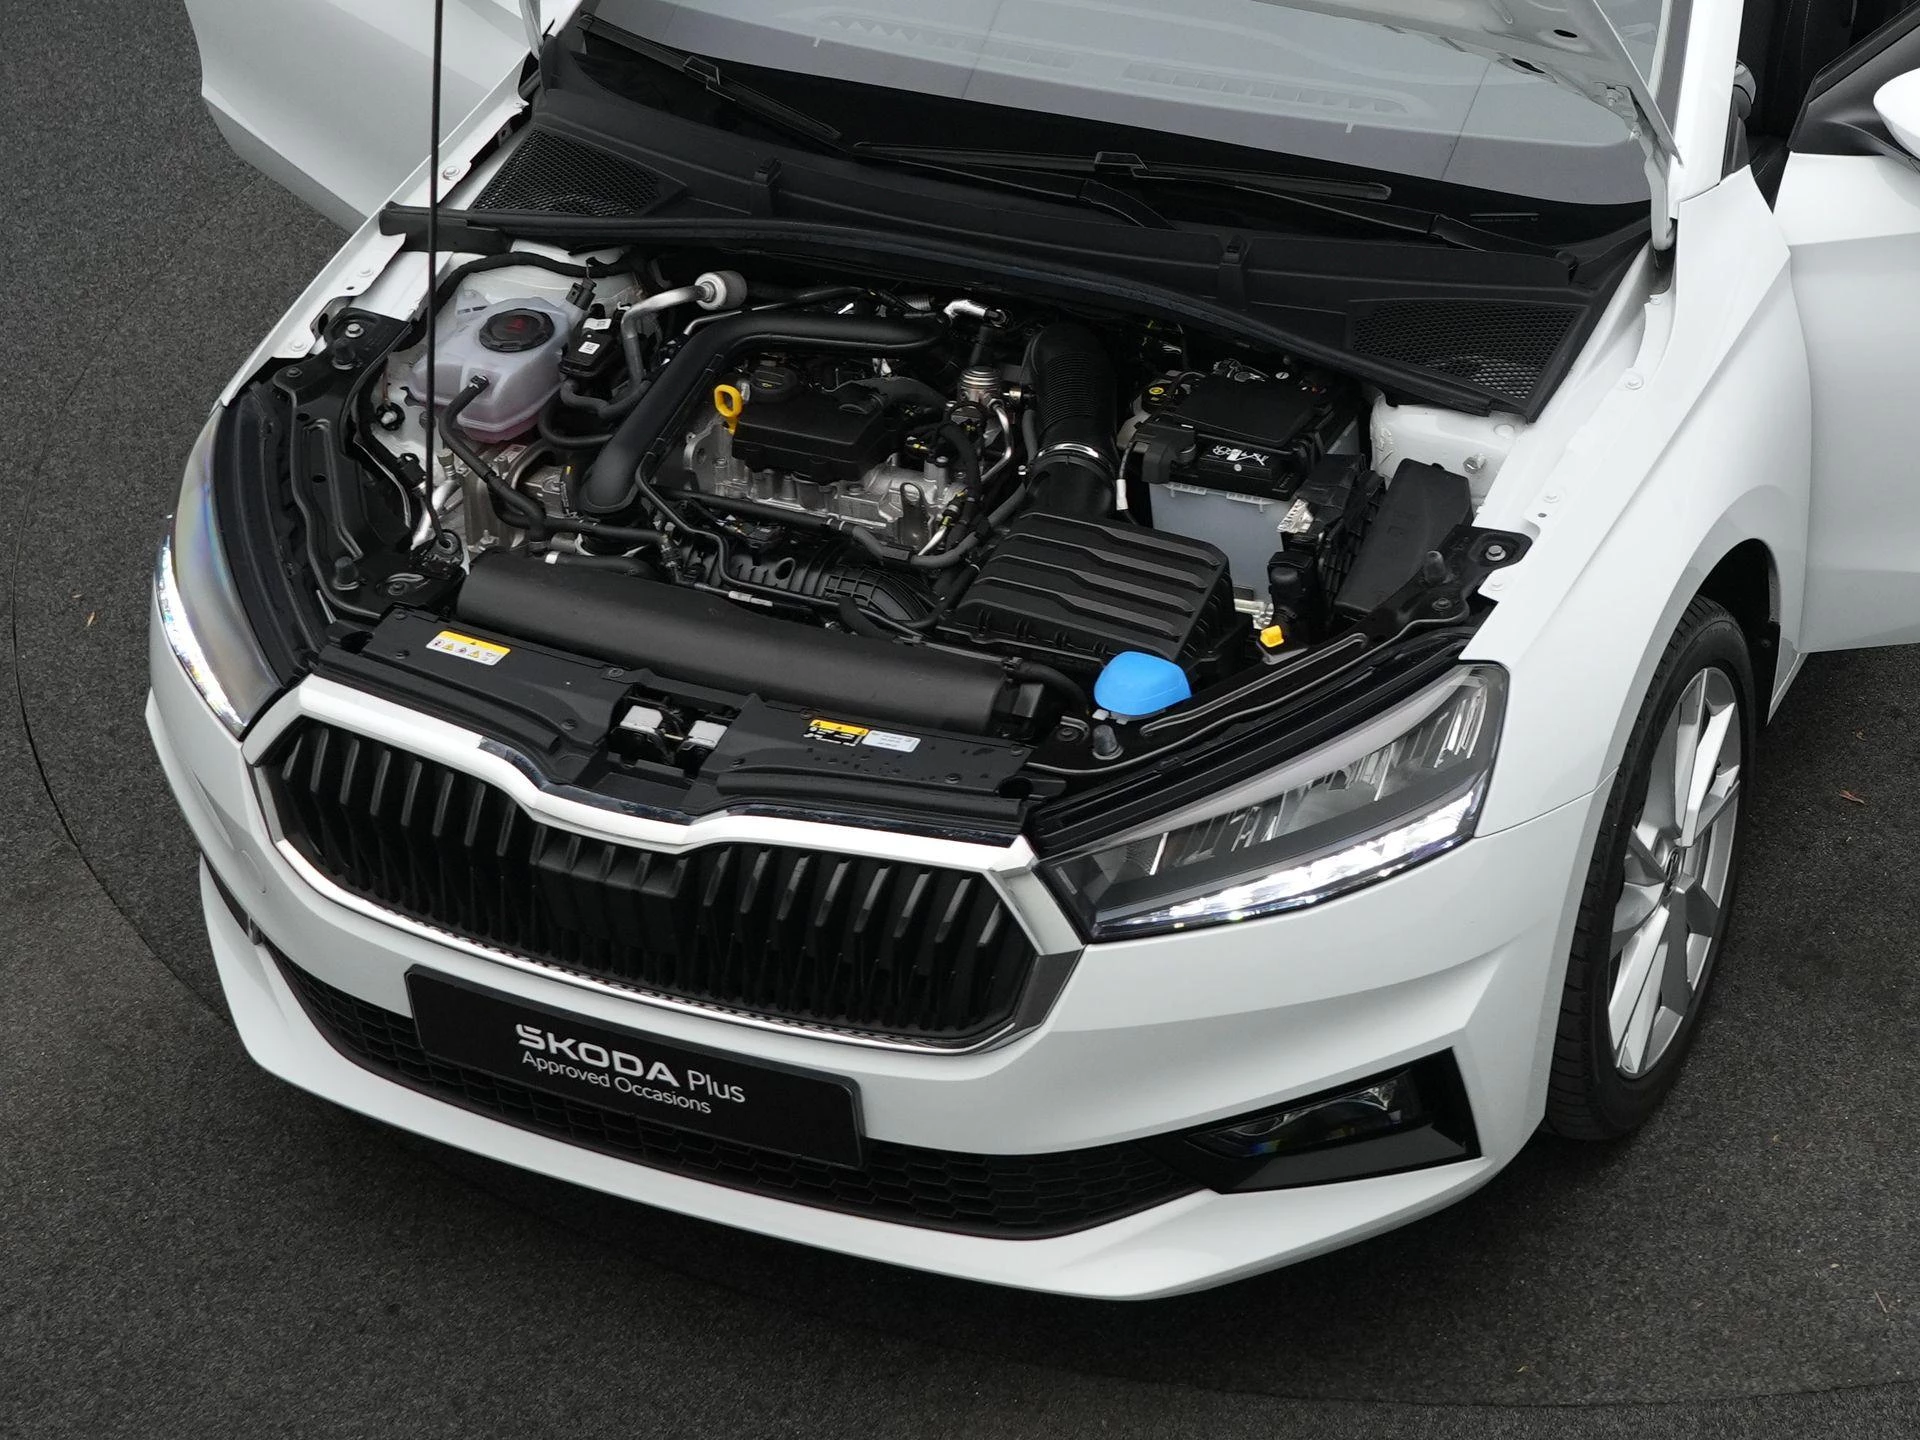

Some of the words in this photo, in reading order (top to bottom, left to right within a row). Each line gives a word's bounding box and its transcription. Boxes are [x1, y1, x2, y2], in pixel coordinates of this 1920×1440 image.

[522, 1050, 611, 1088] Approved
[614, 1076, 712, 1114] Occasions
[686, 1069, 746, 1103] Plus
